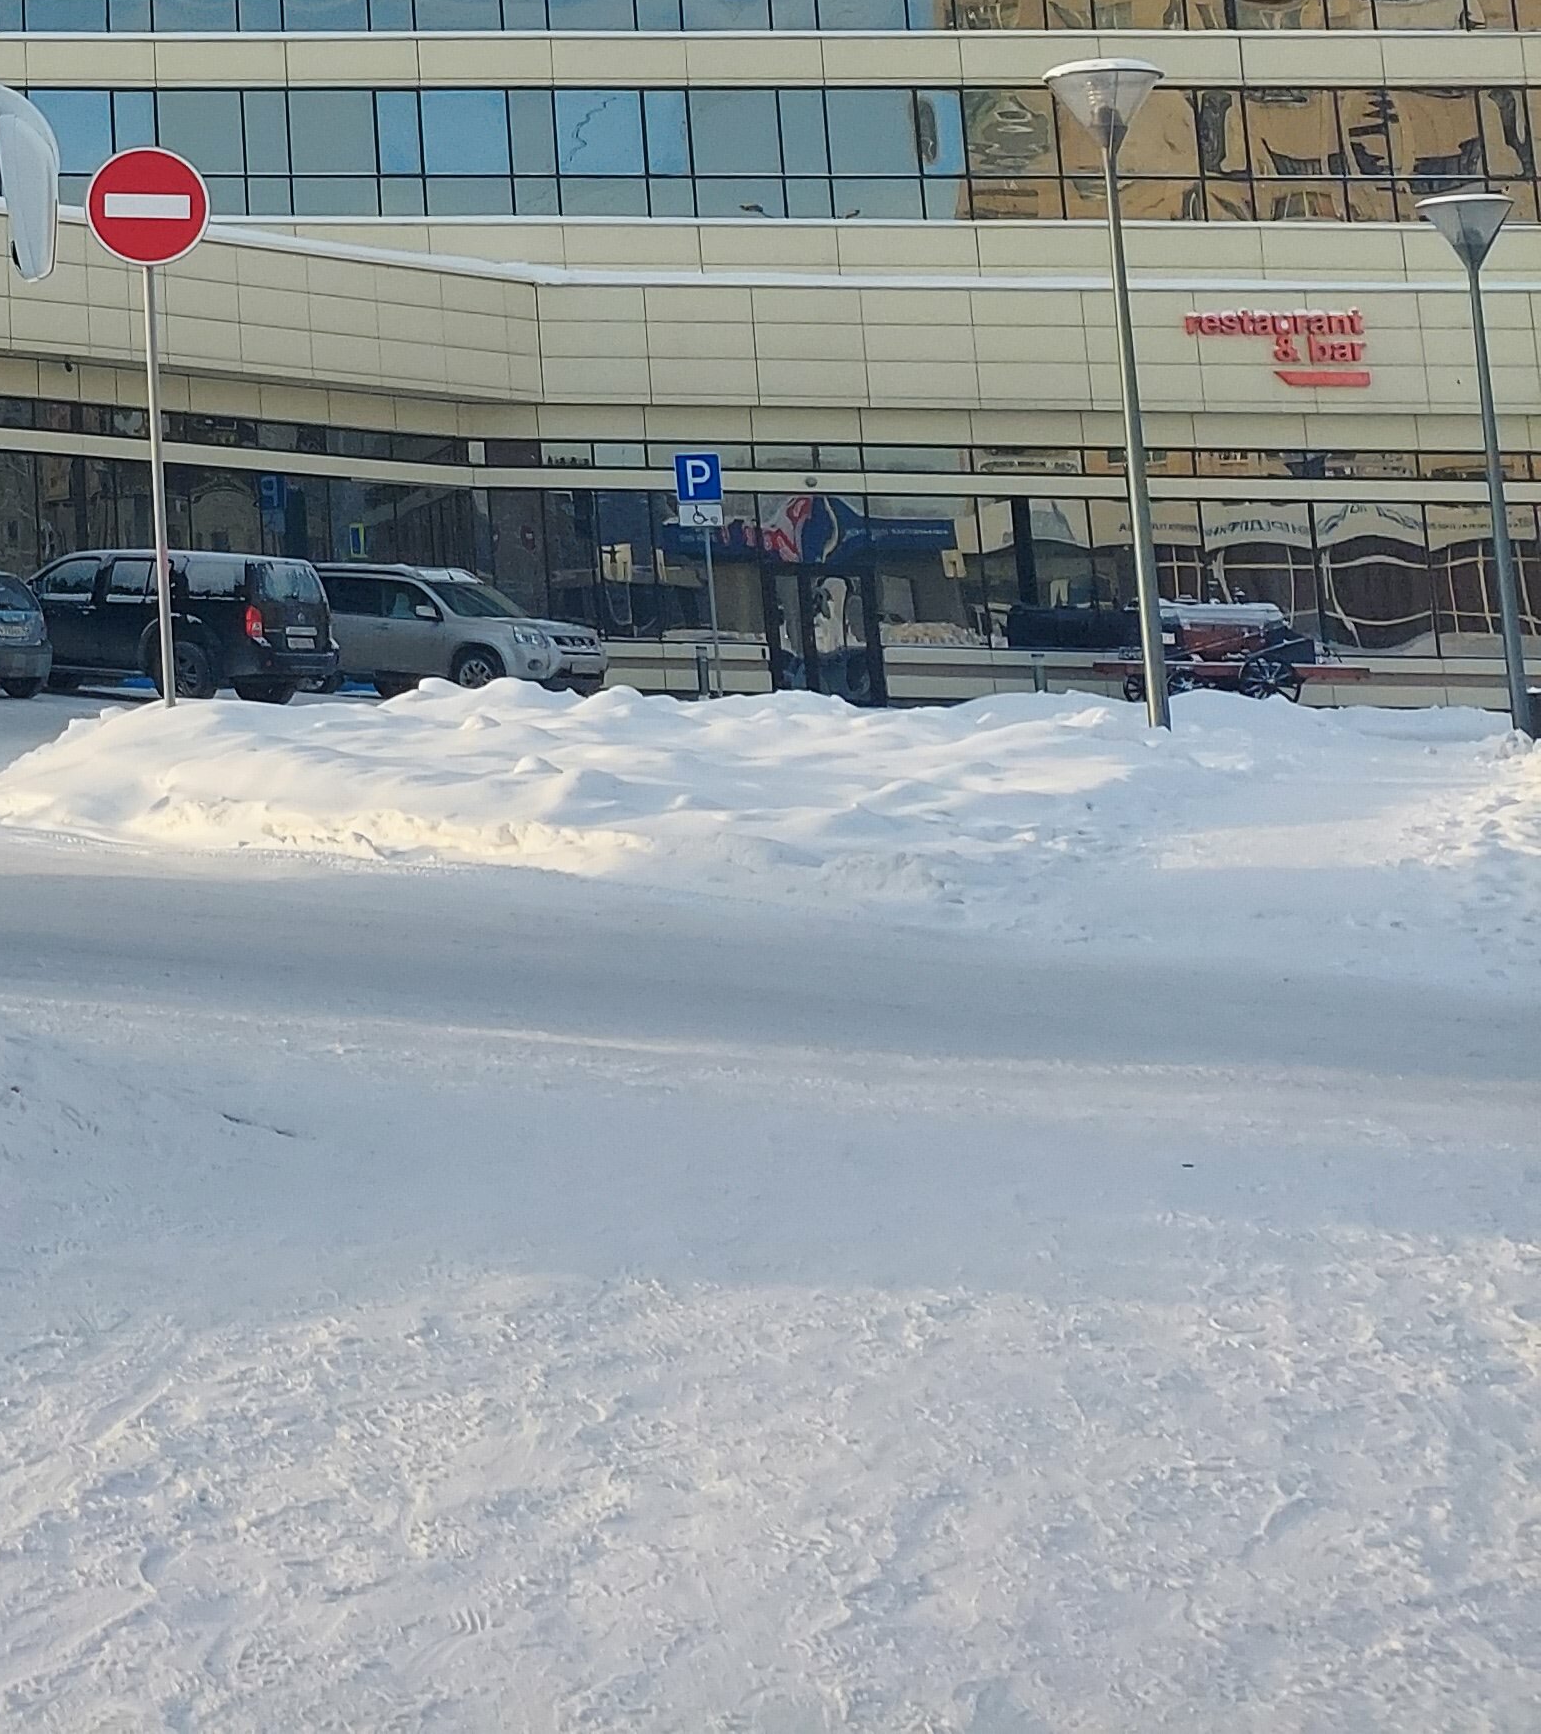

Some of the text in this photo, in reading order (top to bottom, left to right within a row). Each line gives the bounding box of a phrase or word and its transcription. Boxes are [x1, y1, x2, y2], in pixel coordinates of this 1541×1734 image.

[1184, 308, 1364, 336] restaurant
[1274, 335, 1366, 364] & bar
[686, 460, 710, 496] P
